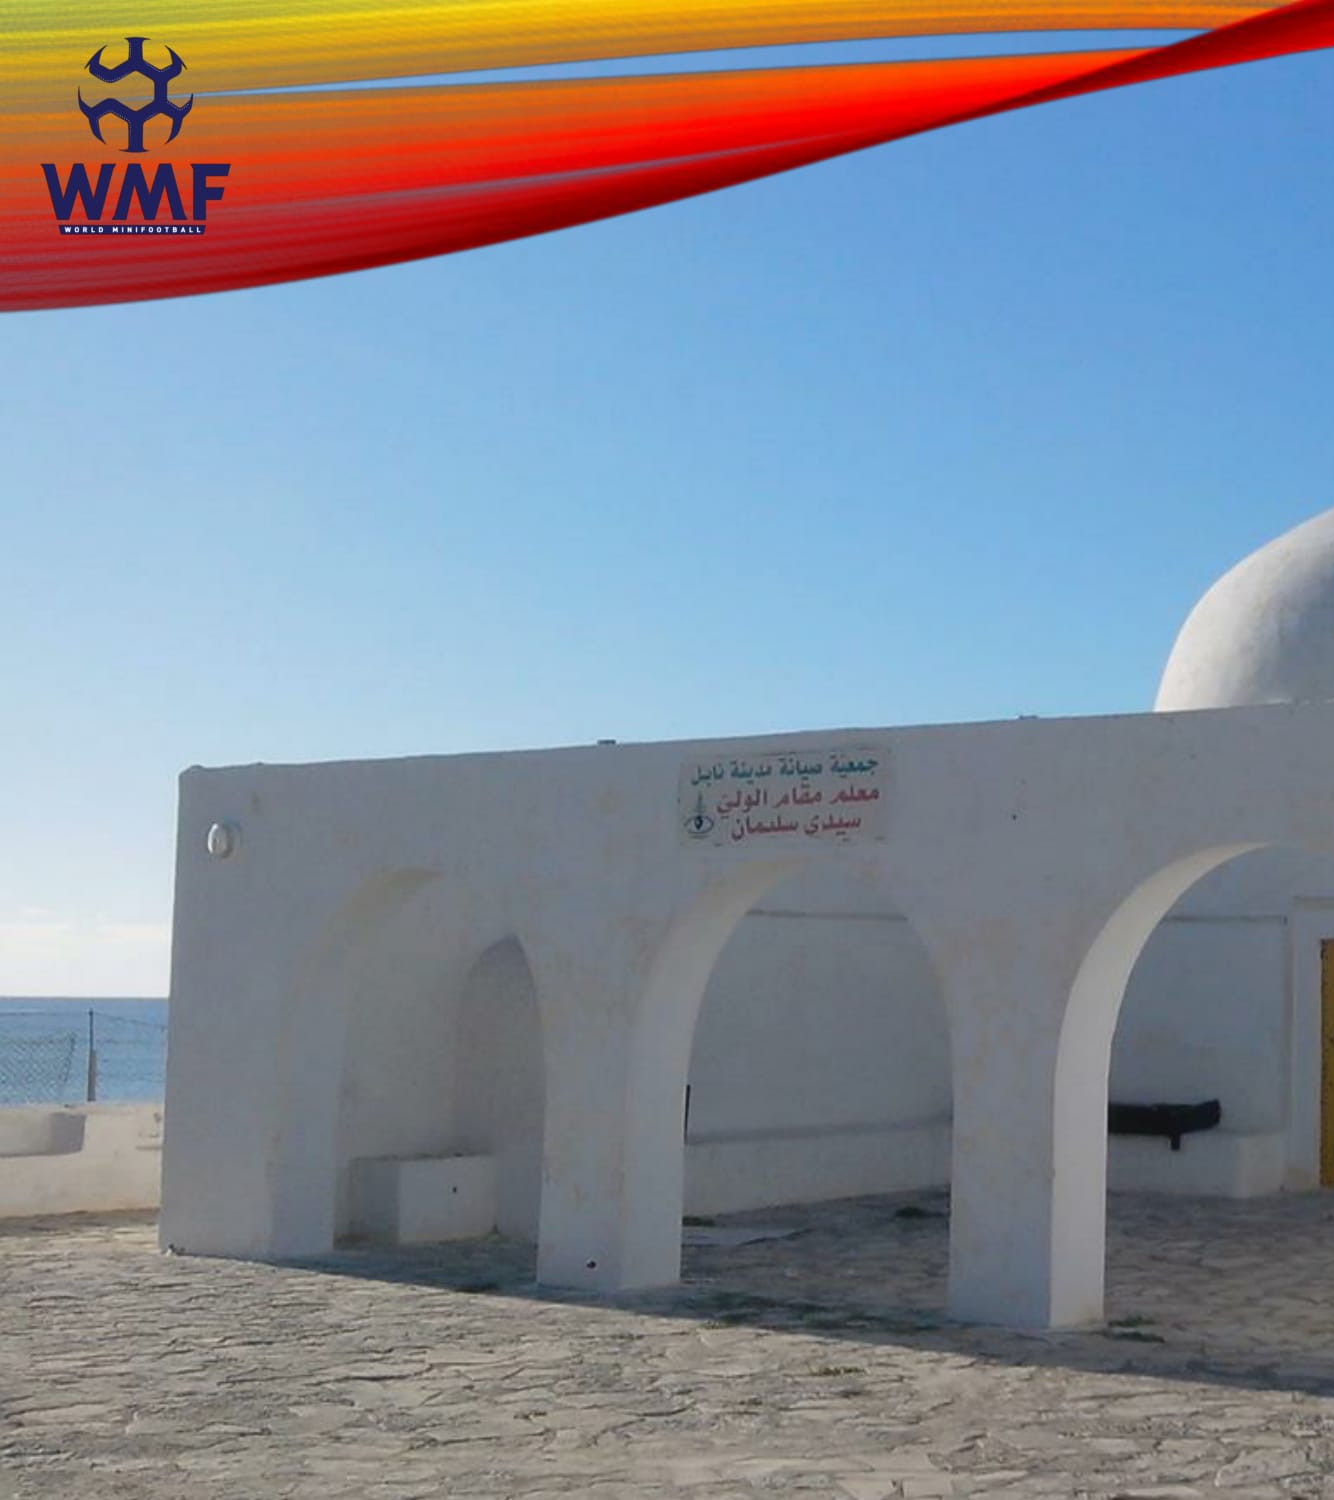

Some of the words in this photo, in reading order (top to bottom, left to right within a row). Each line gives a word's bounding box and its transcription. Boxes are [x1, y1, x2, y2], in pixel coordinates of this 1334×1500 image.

[691, 763, 725, 788] نابل
[730, 759, 773, 784] مدينة
[779, 757, 823, 781] صيانة
[831, 753, 879, 777] جمعية
[773, 783, 823, 809] مقام
[829, 785, 880, 806] معلم
